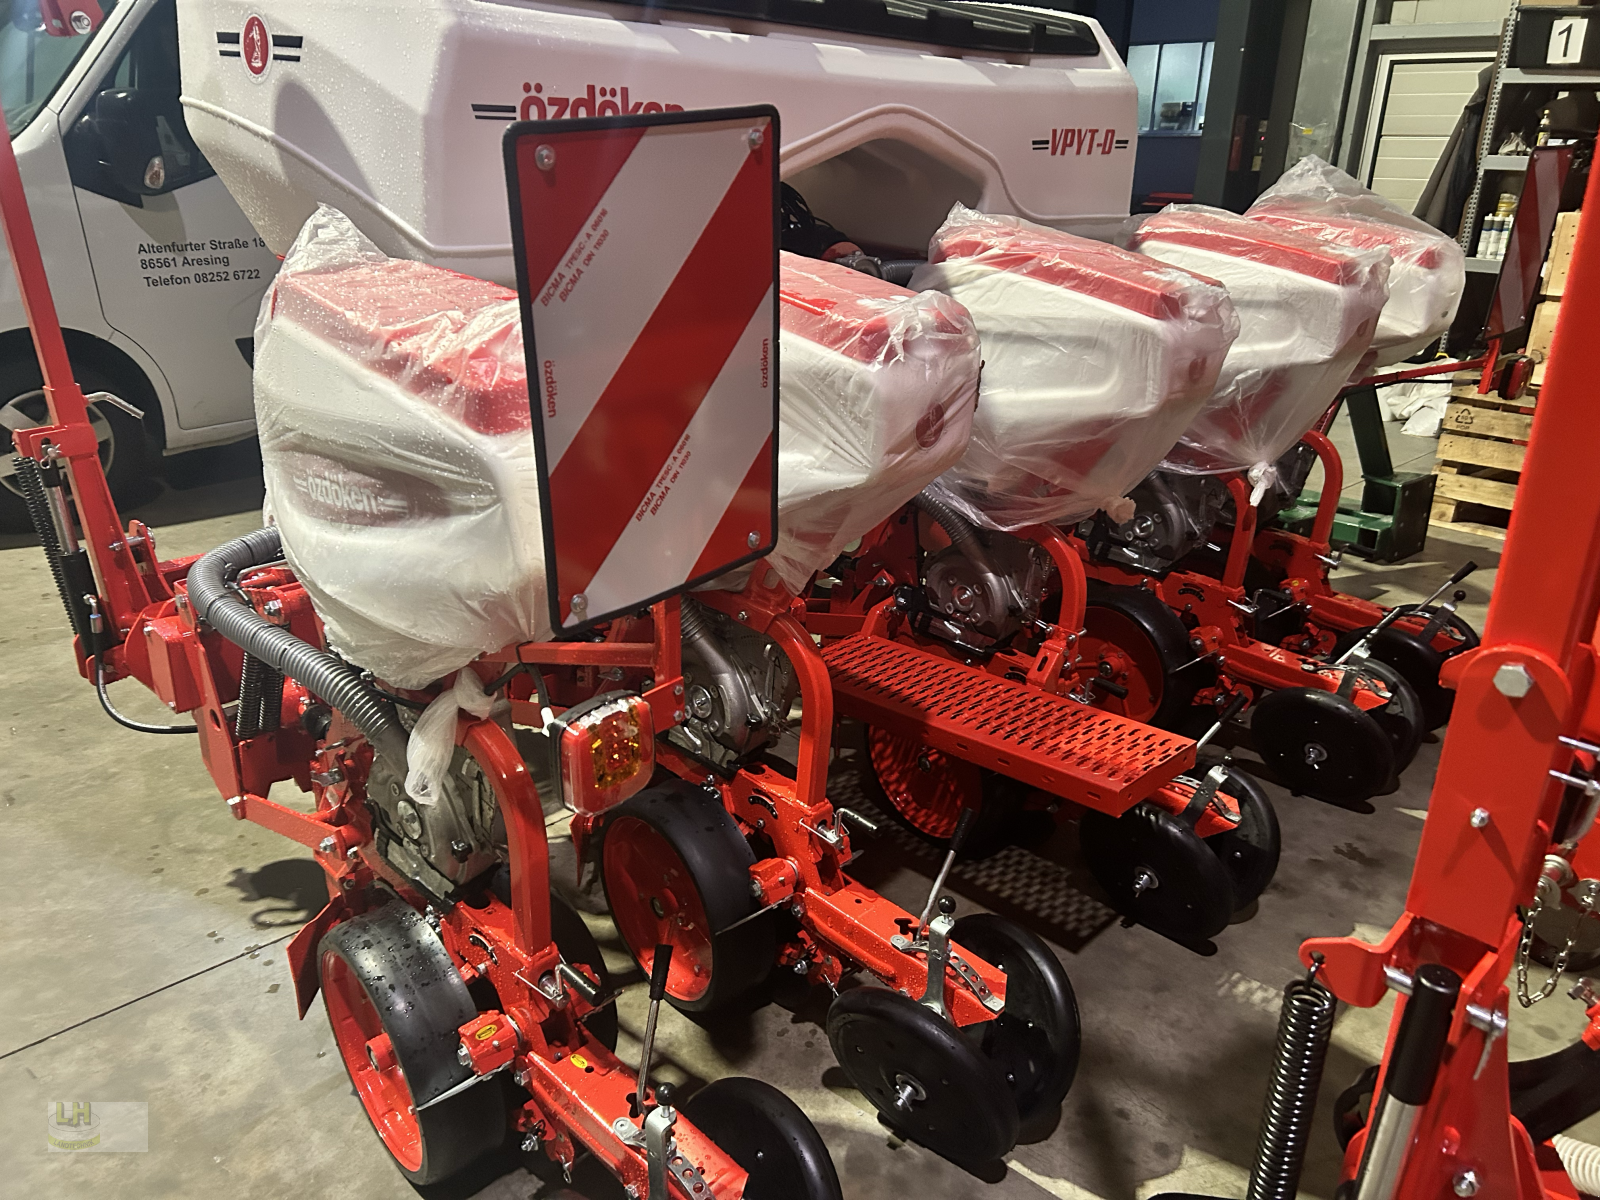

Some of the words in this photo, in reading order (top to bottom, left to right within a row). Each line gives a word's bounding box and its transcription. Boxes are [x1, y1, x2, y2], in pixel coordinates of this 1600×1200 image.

[1557, 23, 1573, 57] 1
[1051, 128, 1116, 156] VPYT-D
[138, 242, 205, 253] Altenfurter
[210, 239, 248, 250] Straße
[140, 257, 177, 269] 86561
[181, 254, 230, 267] Aresing
[144, 275, 190, 286] Telefon
[194, 271, 230, 283] 08252
[233, 269, 261, 280] 6722
[541, 273, 565, 306] BICMA
[559, 268, 584, 302] BICMA
[583, 251, 595, 266] DIN
[544, 360, 558, 418] özdöken
[636, 492, 656, 521] BICMA
[650, 486, 670, 515] BICMA
[670, 471, 679, 483] DIN
